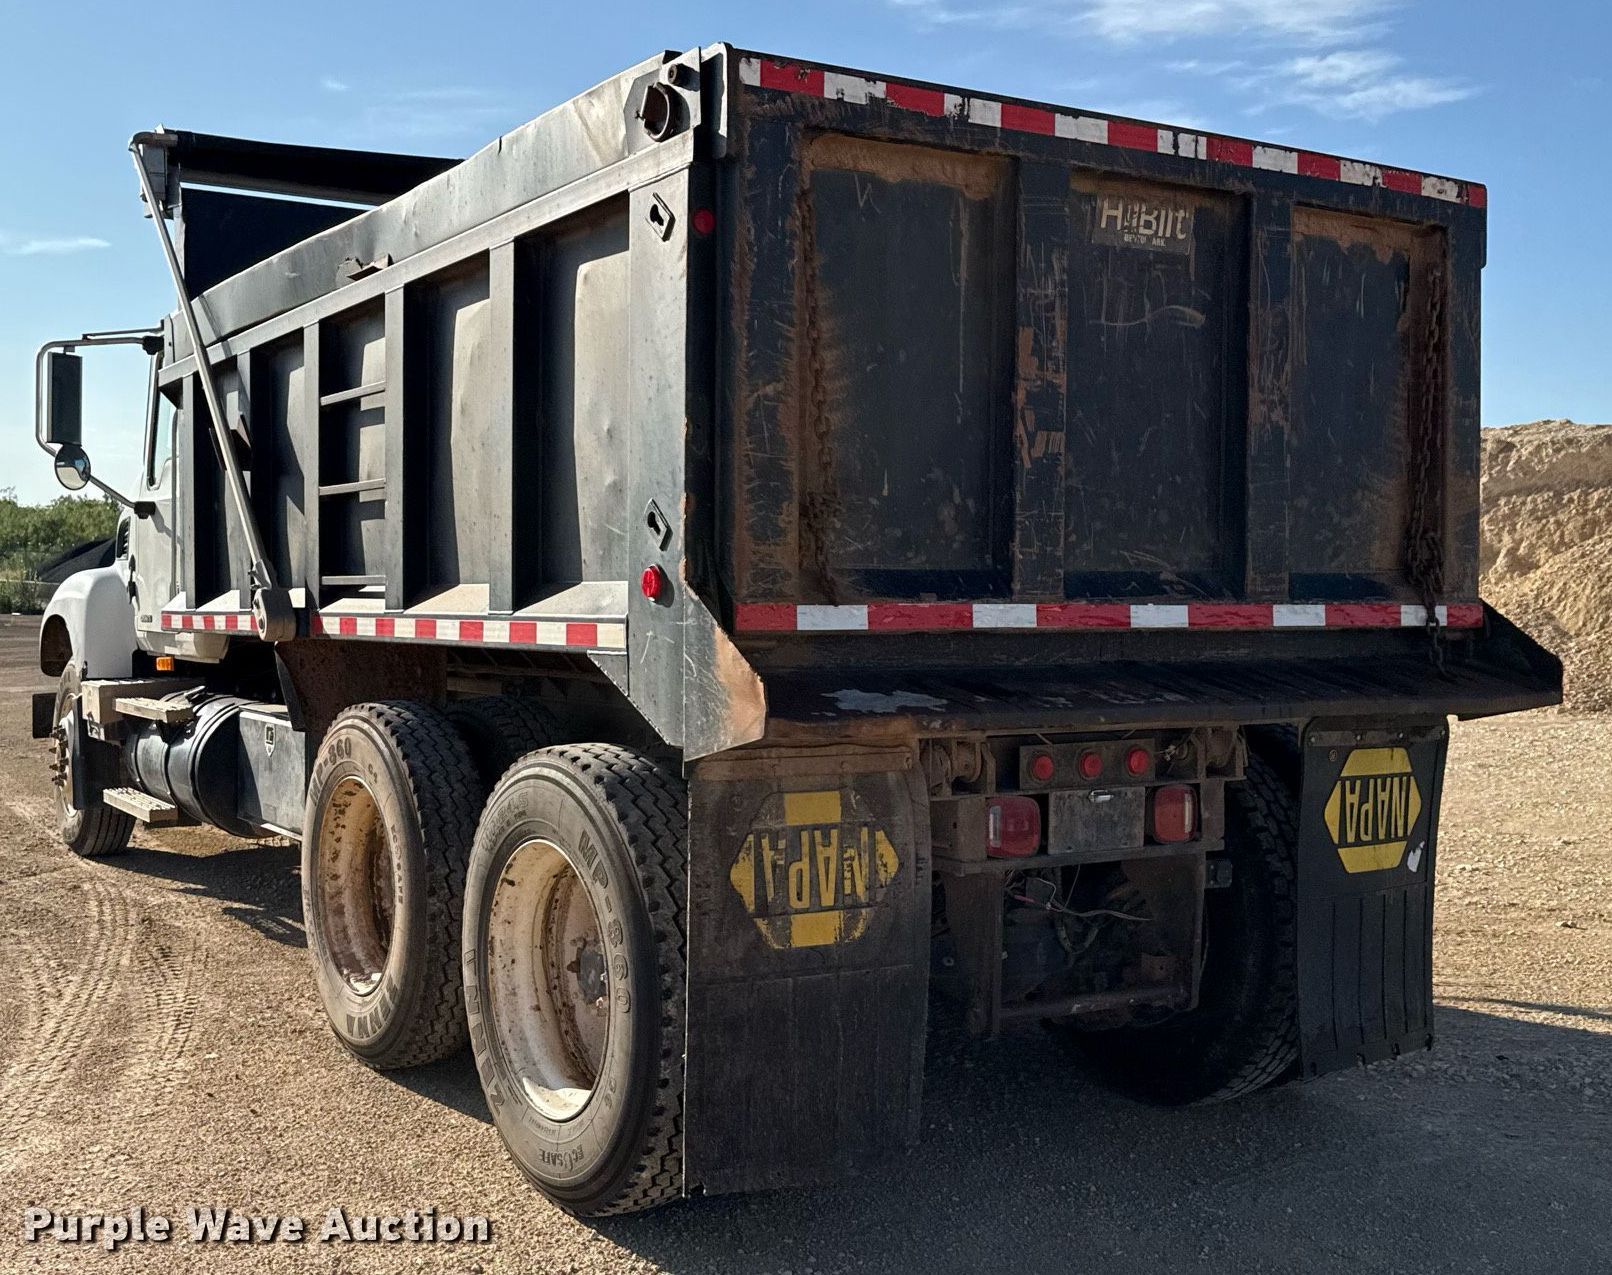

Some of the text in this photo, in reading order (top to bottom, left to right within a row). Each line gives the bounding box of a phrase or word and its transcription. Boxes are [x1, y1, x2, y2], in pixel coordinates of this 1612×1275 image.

[309, 736, 352, 807] MP-860
[1345, 775, 1407, 843] NAPA
[761, 826, 868, 909] NAPA
[578, 830, 632, 1014] MP-860
